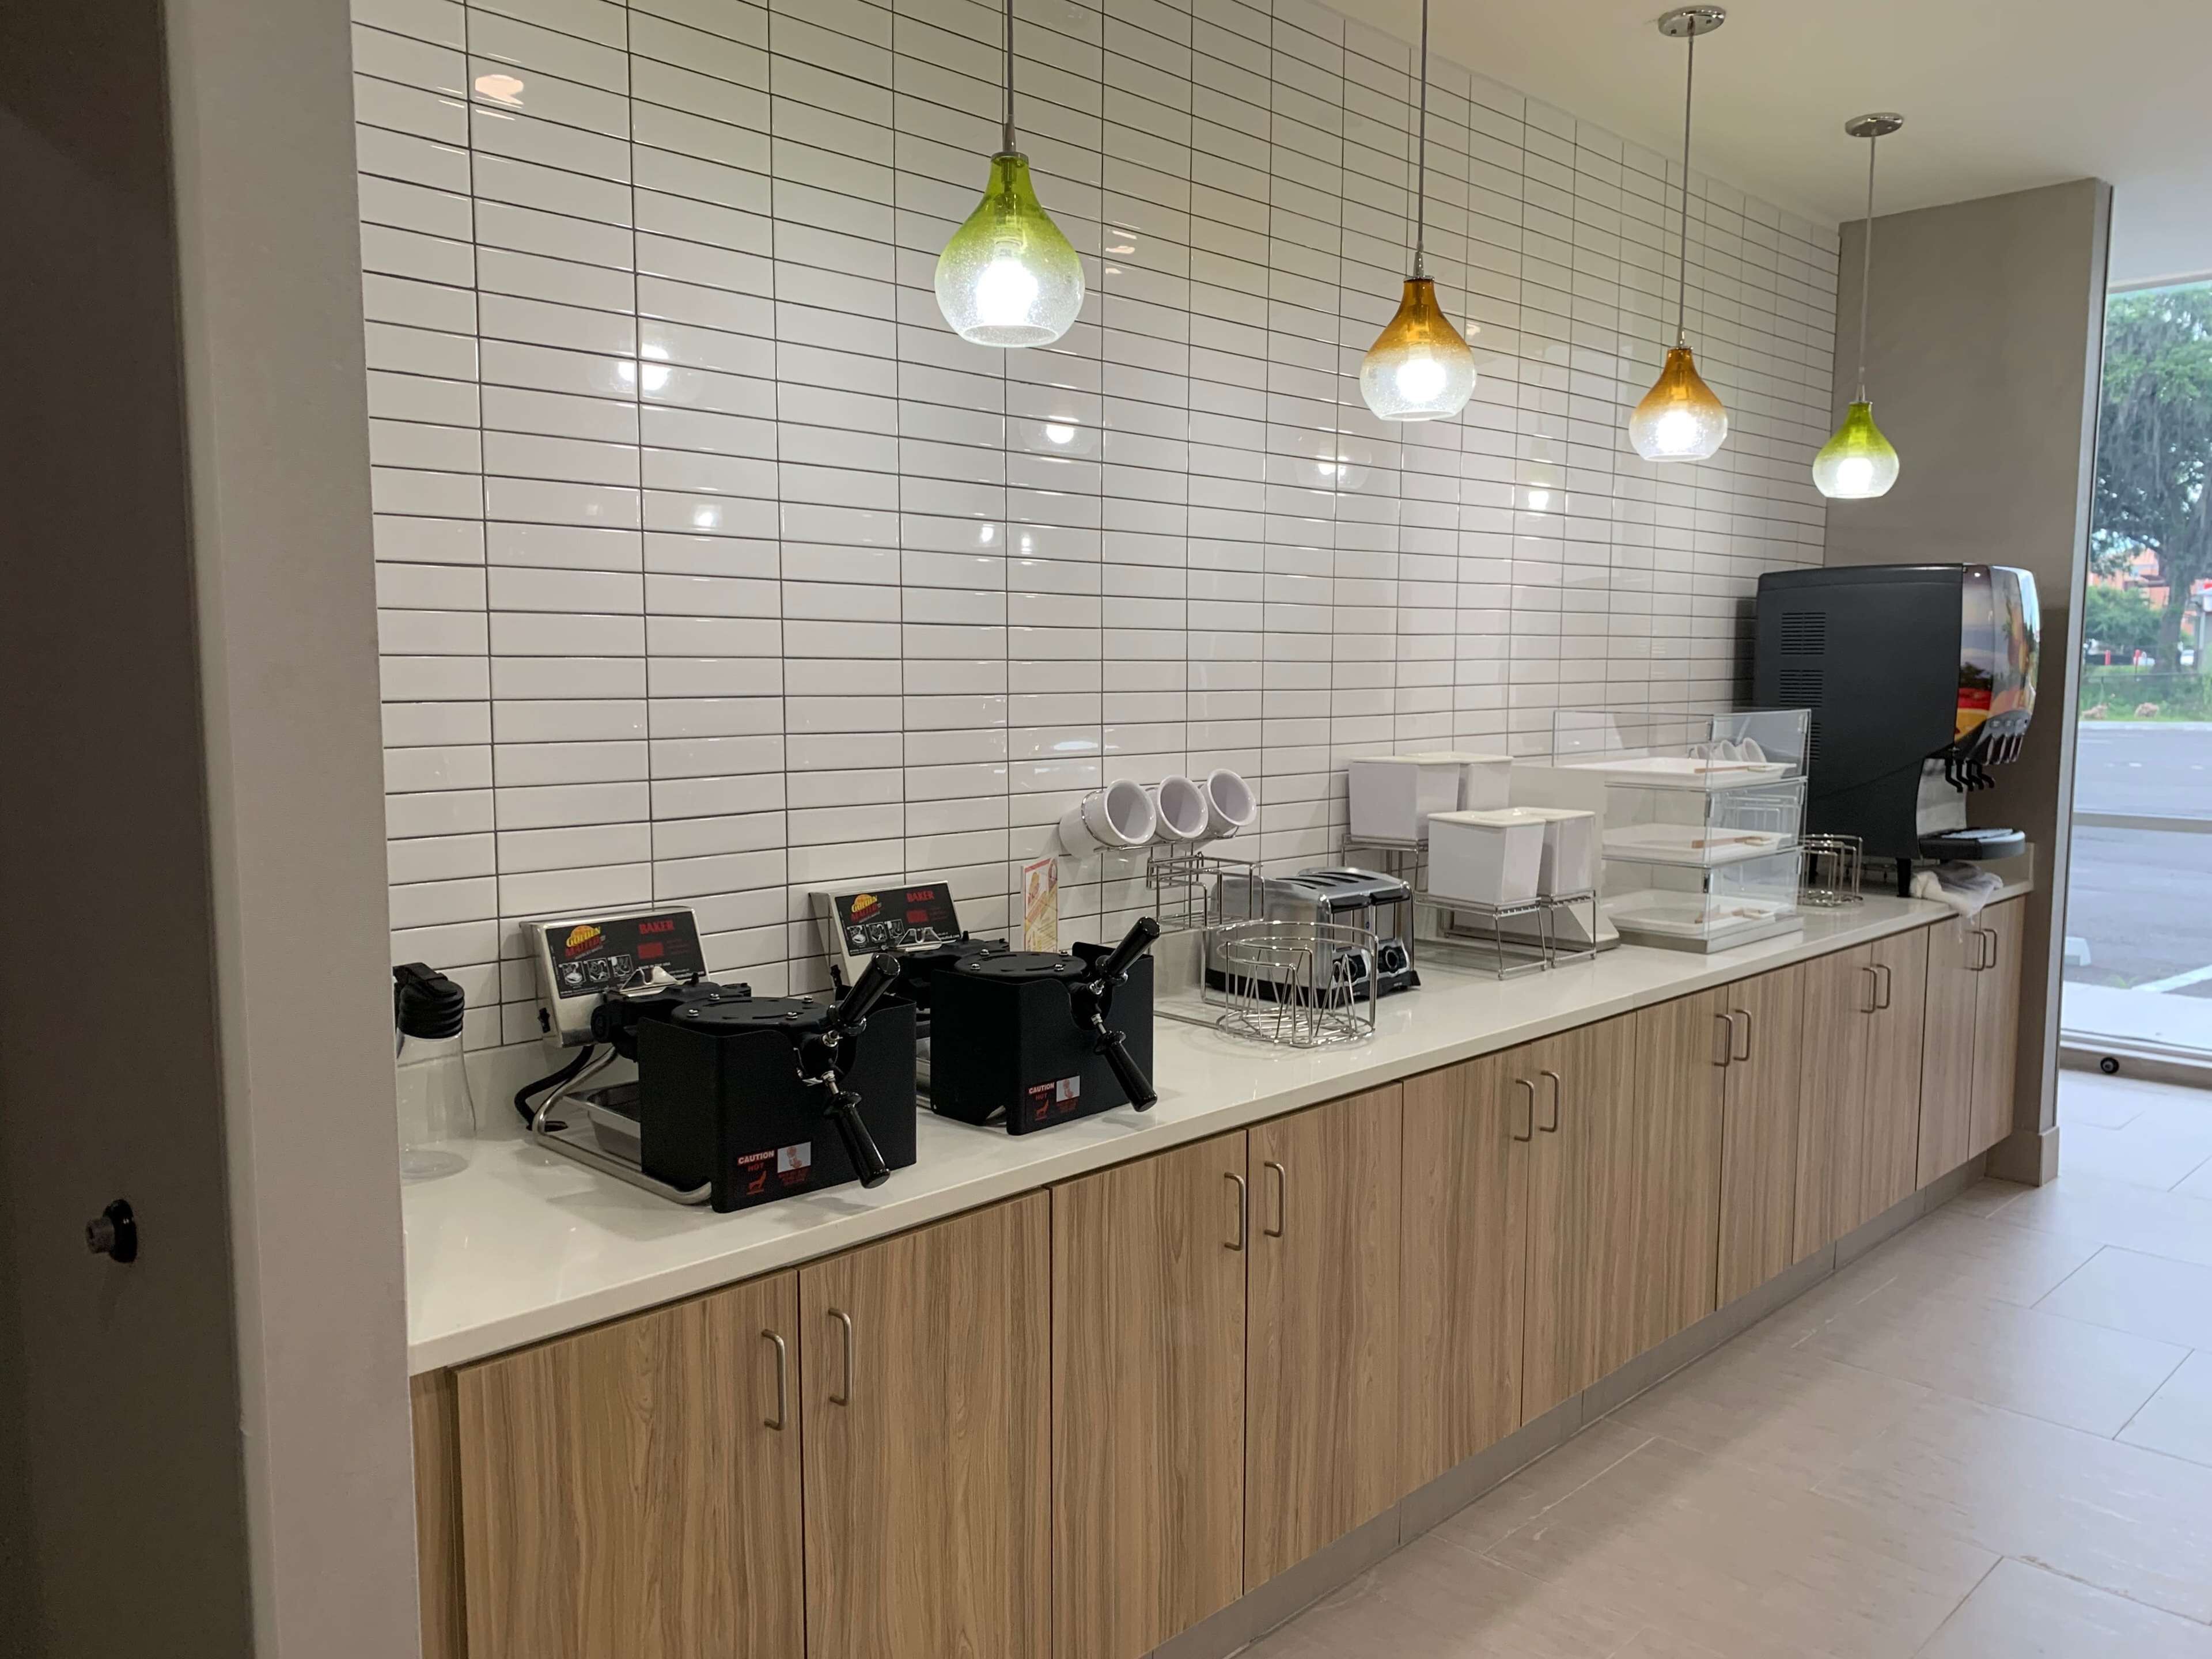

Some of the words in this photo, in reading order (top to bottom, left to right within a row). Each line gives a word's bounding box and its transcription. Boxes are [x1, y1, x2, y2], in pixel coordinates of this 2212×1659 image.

[906, 891, 934, 903] BAKER
[638, 919, 675, 934] BAKER
[1028, 1082, 1055, 1094] CAUTION
[738, 1150, 774, 1164] CAUTION
[748, 1162, 764, 1172] HOT
